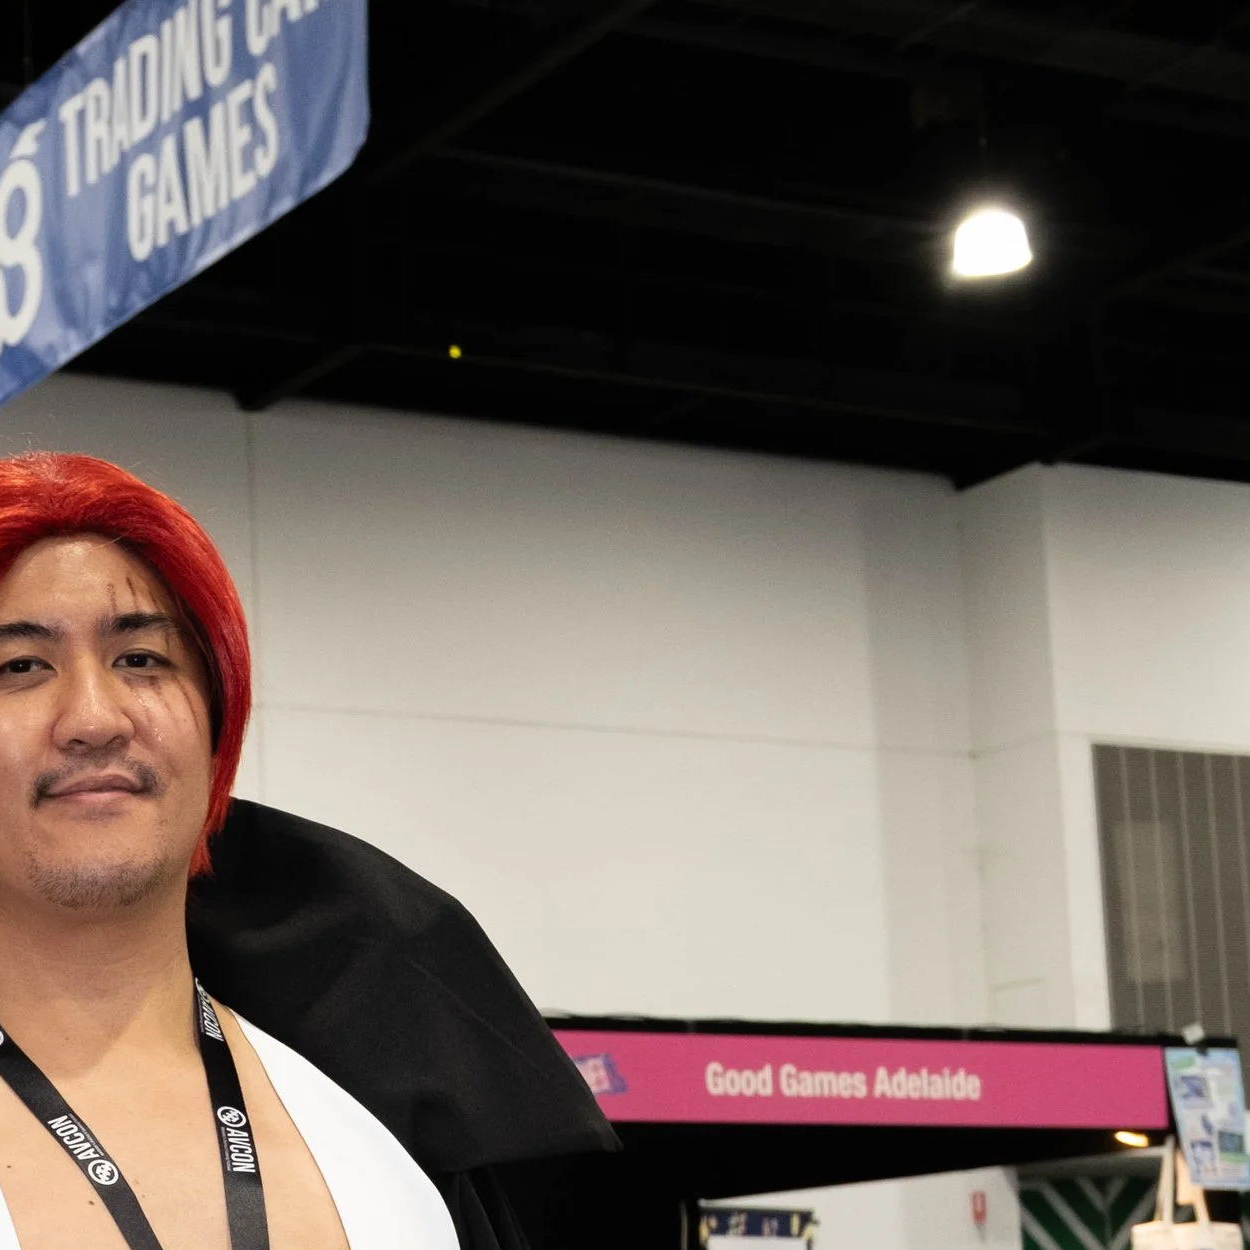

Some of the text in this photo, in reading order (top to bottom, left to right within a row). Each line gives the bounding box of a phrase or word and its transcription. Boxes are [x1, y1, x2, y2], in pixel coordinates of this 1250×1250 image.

[60, 0, 233, 197] TRADING
[127, 62, 279, 262] GAMES
[705, 1061, 982, 1101] Good Games Adelaide
[47, 1114, 101, 1161] AVCON
[226, 1127, 257, 1173] AVCON
